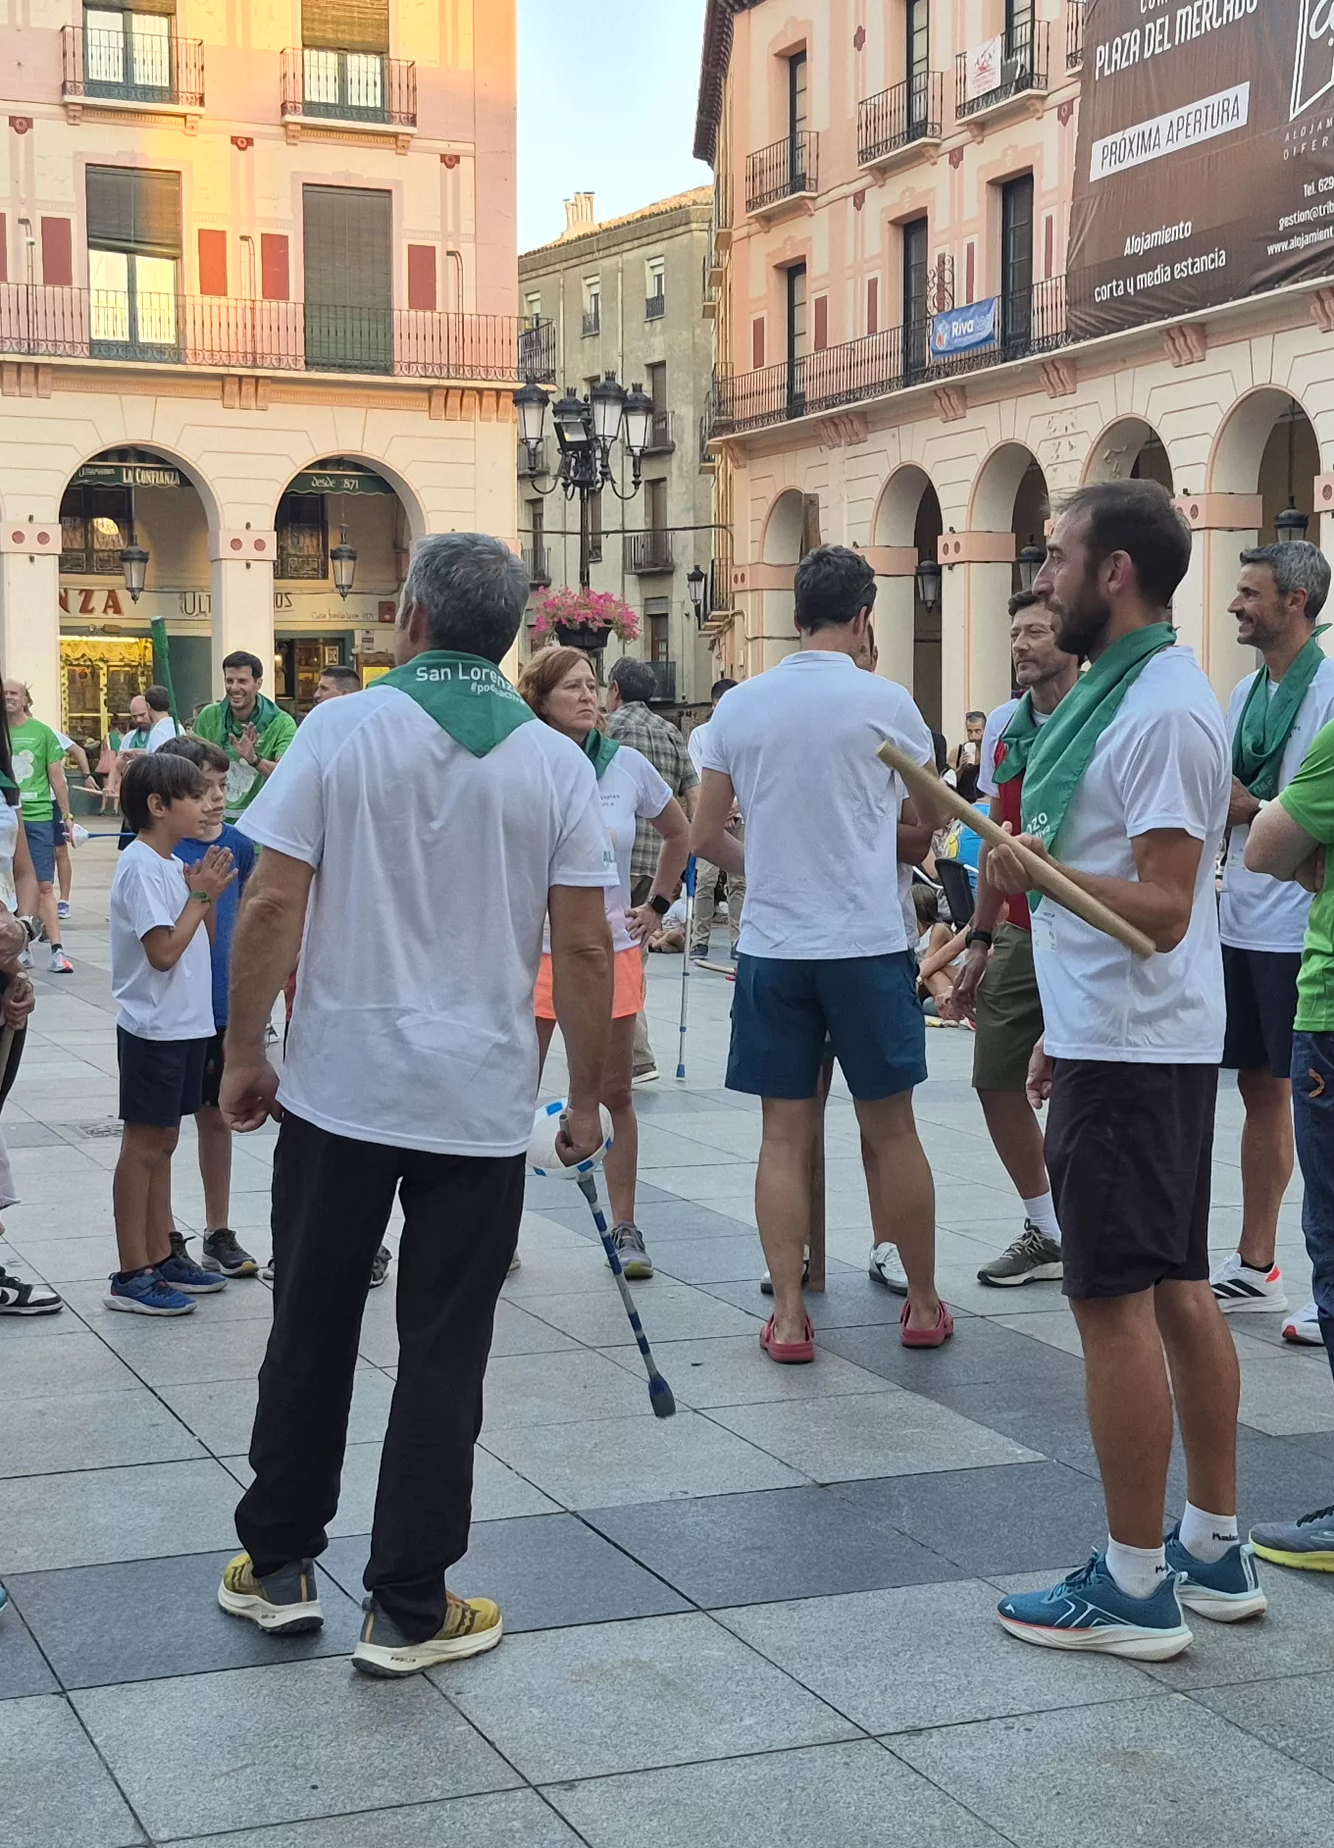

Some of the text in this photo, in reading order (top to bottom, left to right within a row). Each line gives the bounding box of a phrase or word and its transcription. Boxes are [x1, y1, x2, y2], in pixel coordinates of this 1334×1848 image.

[1095, 28, 1141, 81] PLAZA
[1143, 14, 1172, 60] DEL
[1174, 0, 1258, 46] MERCADO
[1101, 93, 1240, 170] PRÓXIMA APERTURA
[1303, 182, 1316, 198] Tel.
[1318, 175, 1334, 193] 629
[1123, 220, 1192, 257] Alojamiento
[1094, 246, 1226, 303] corta y media estancia
[135, 467, 181, 485] CONFIANZA
[311, 476, 359, 490] desde 871
[416, 662, 519, 693] San Lorenz
